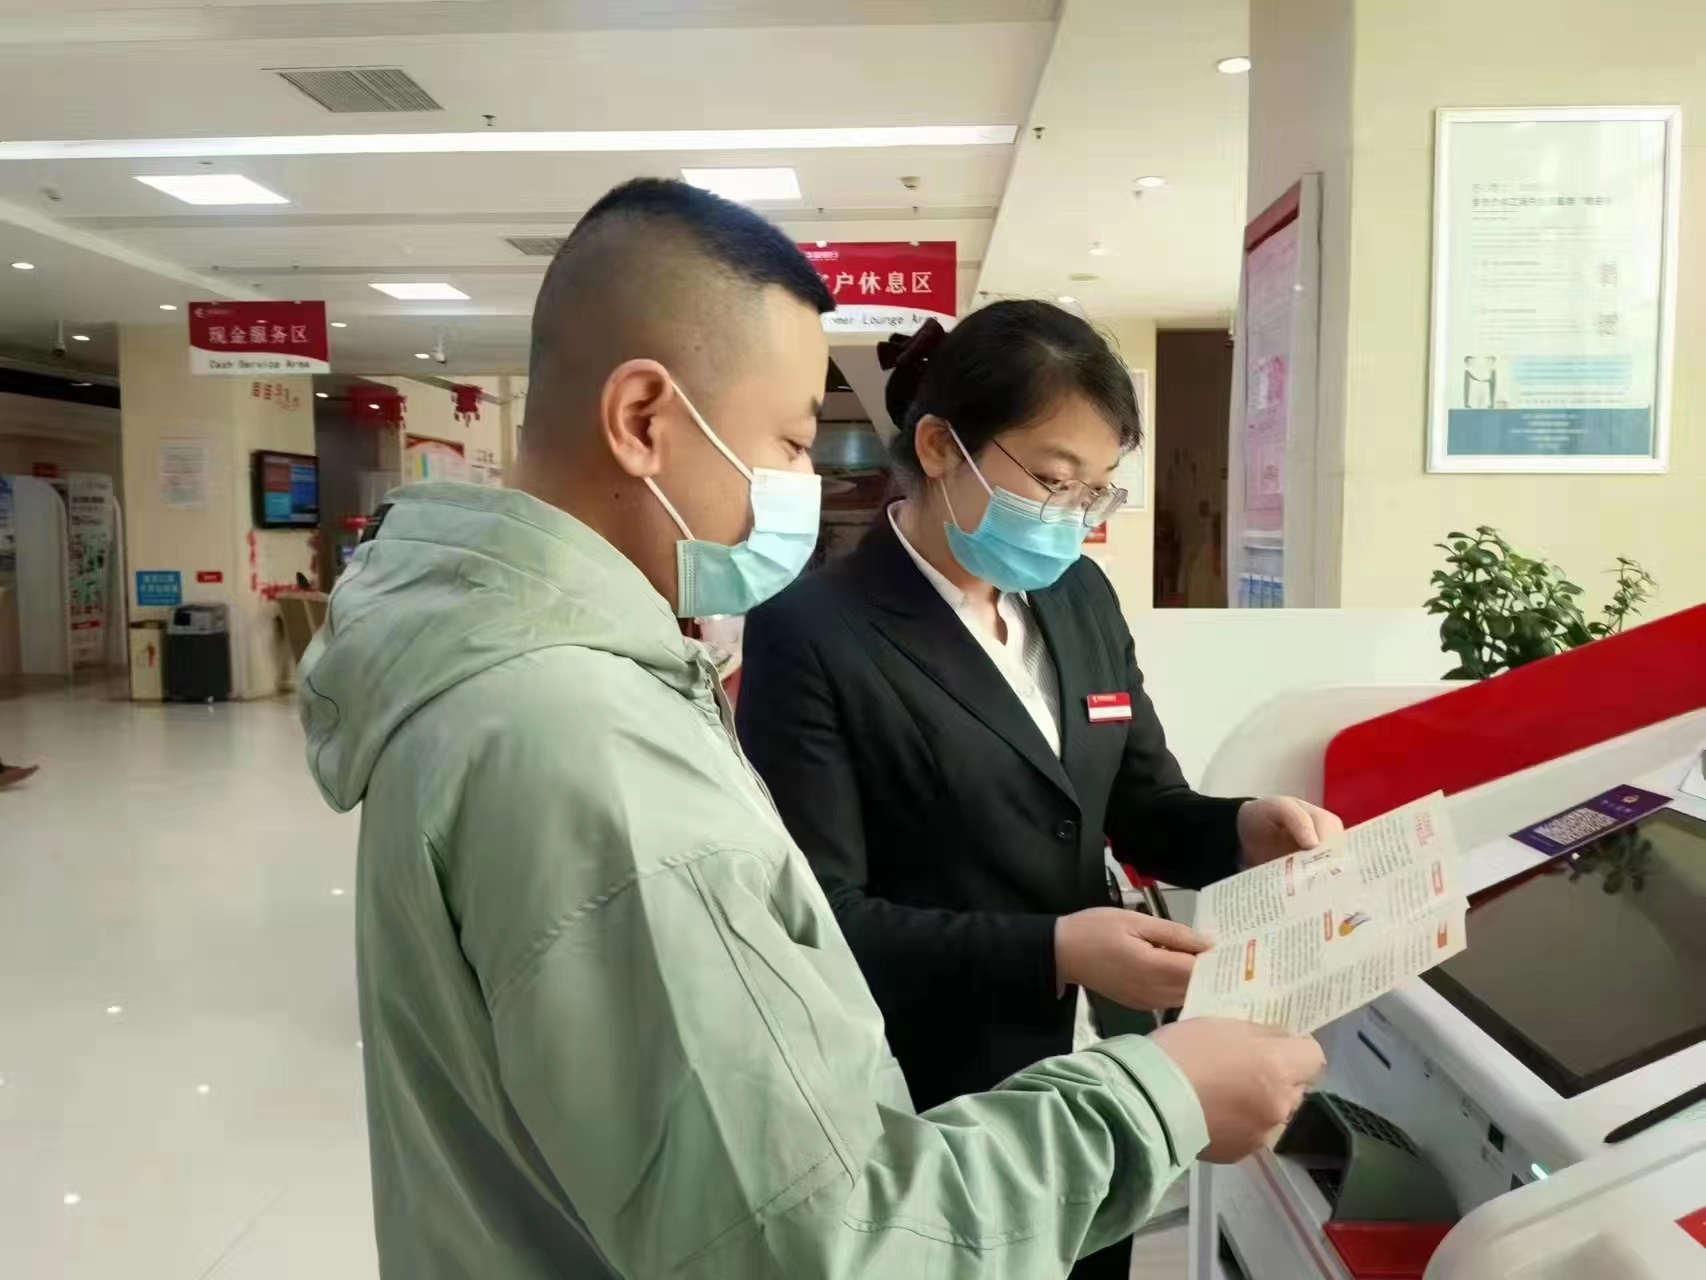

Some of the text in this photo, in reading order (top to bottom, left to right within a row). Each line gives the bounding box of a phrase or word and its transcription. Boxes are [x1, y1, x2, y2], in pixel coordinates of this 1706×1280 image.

[208, 325, 308, 344] 现金服务区
